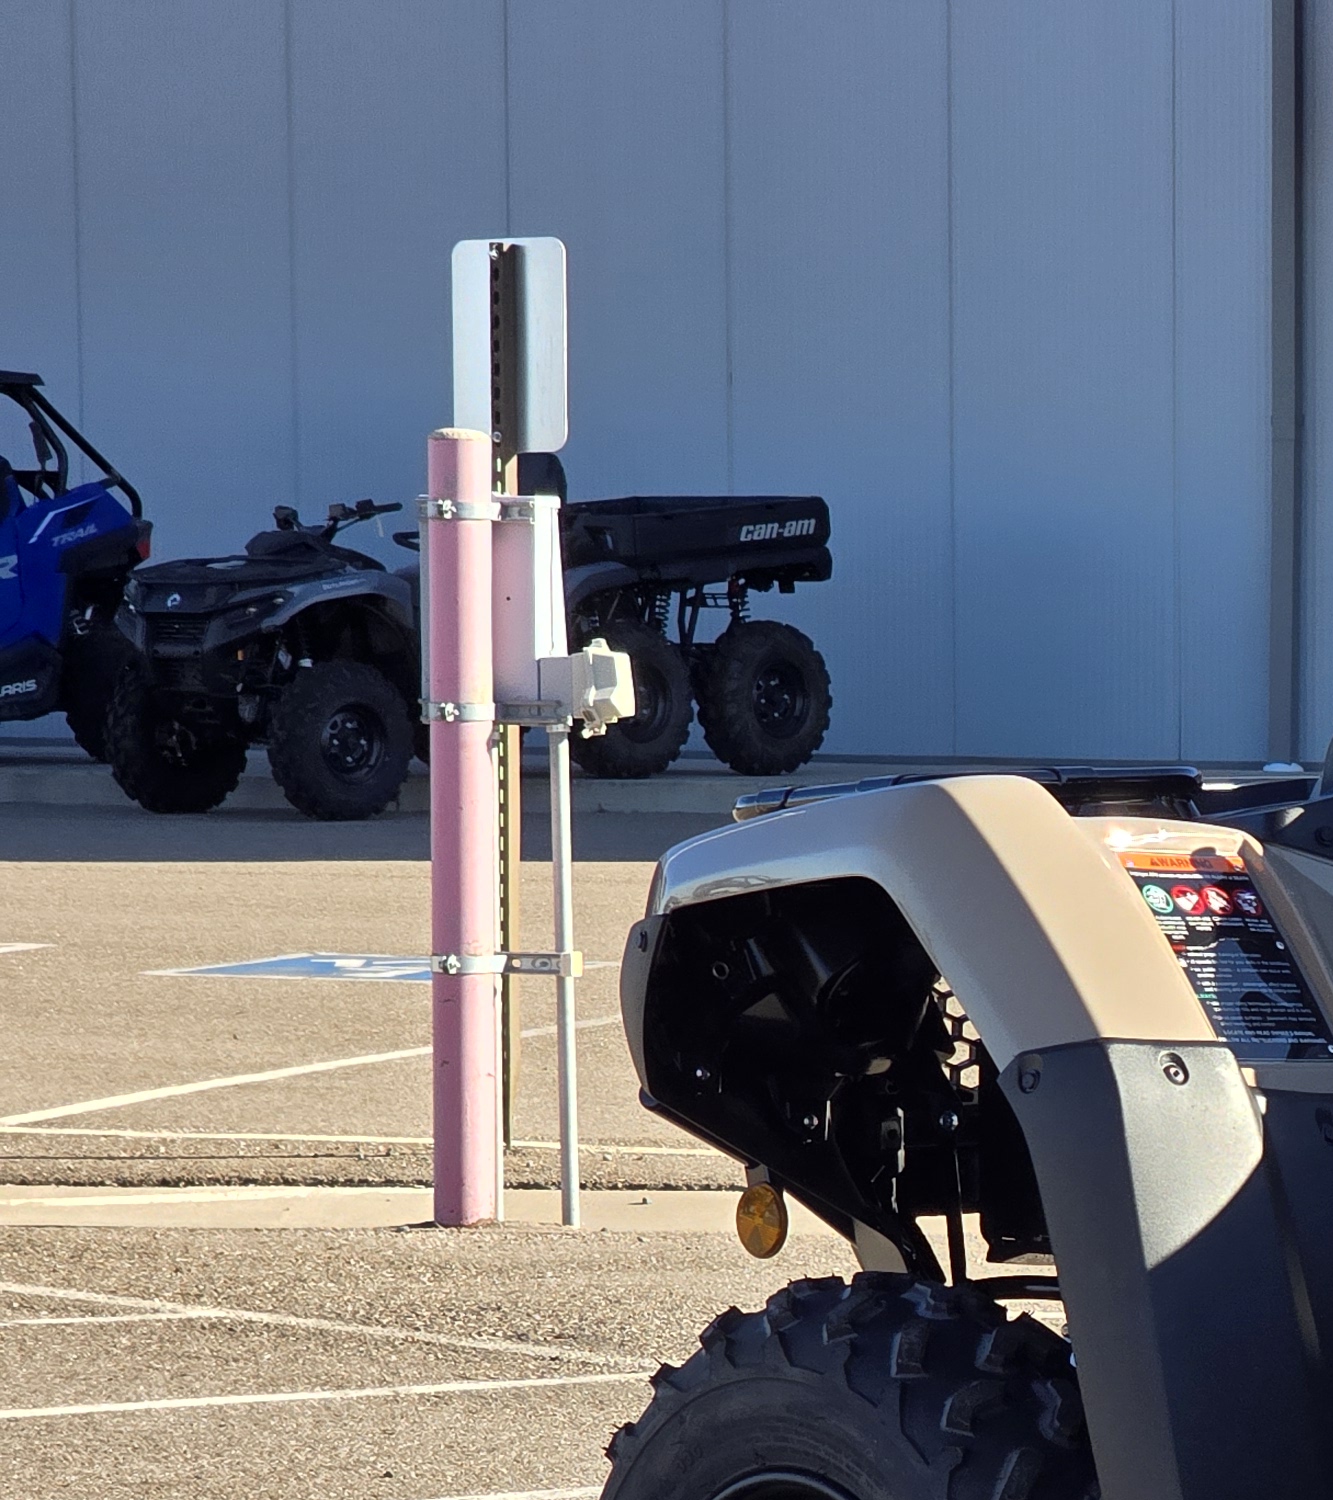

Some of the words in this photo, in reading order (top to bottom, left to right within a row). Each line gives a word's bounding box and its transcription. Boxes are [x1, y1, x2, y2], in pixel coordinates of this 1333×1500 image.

[52, 523, 97, 547] TRAIL
[740, 518, 816, 541] can-am
[1158, 857, 1213, 869] WARNING
